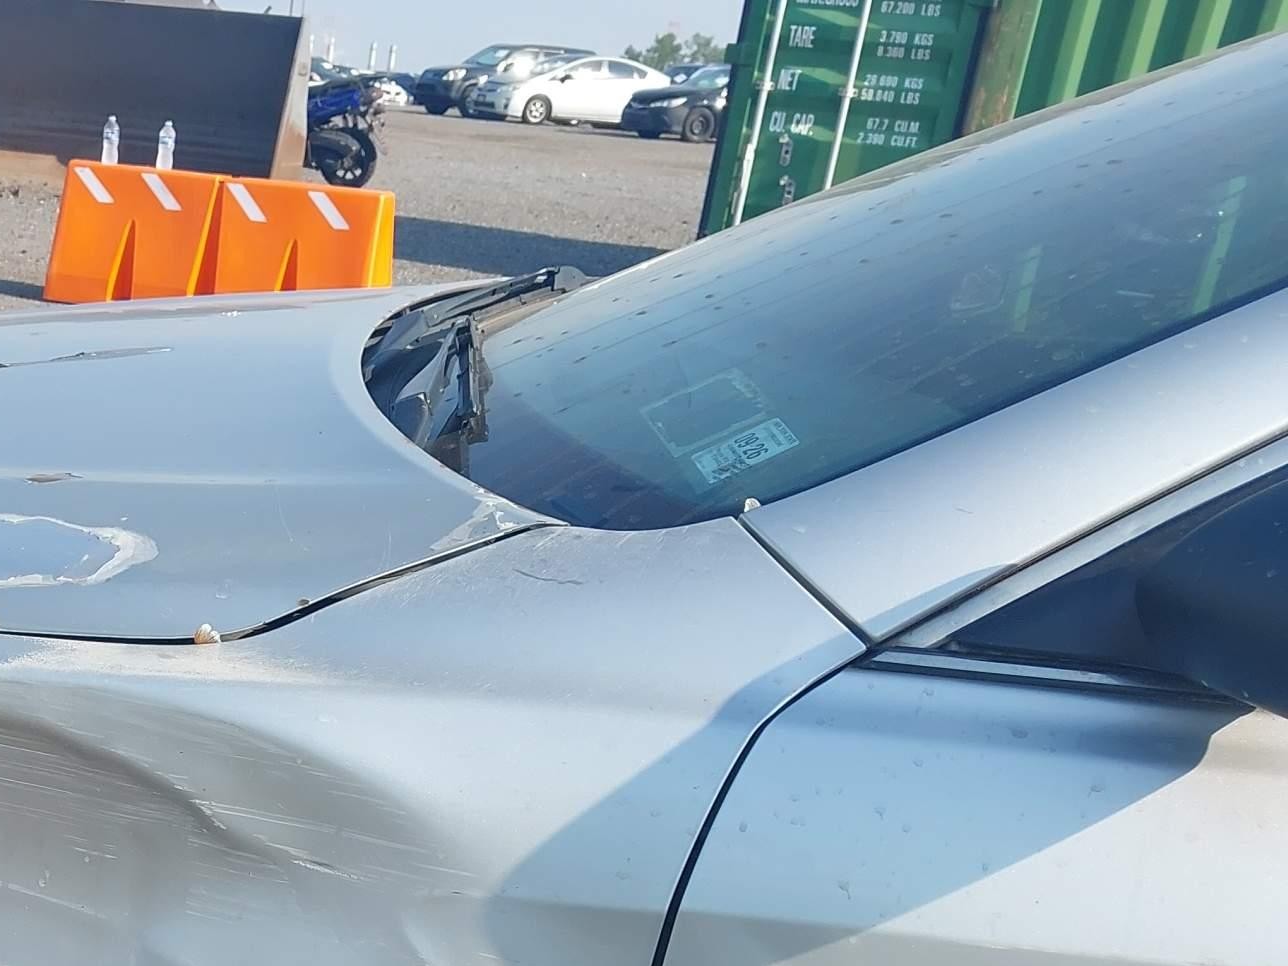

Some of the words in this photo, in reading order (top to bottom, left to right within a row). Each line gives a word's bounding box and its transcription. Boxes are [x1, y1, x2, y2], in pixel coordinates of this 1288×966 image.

[920, 4, 941, 17] LBS
[789, 25, 817, 48] TARE
[913, 33, 935, 46] KGS
[910, 49, 931, 61] LBS
[777, 68, 802, 91] NET
[904, 76, 924, 90] KGS
[900, 91, 920, 105] LBS
[769, 111, 786, 133] CU.
[790, 113, 815, 136] CAP.
